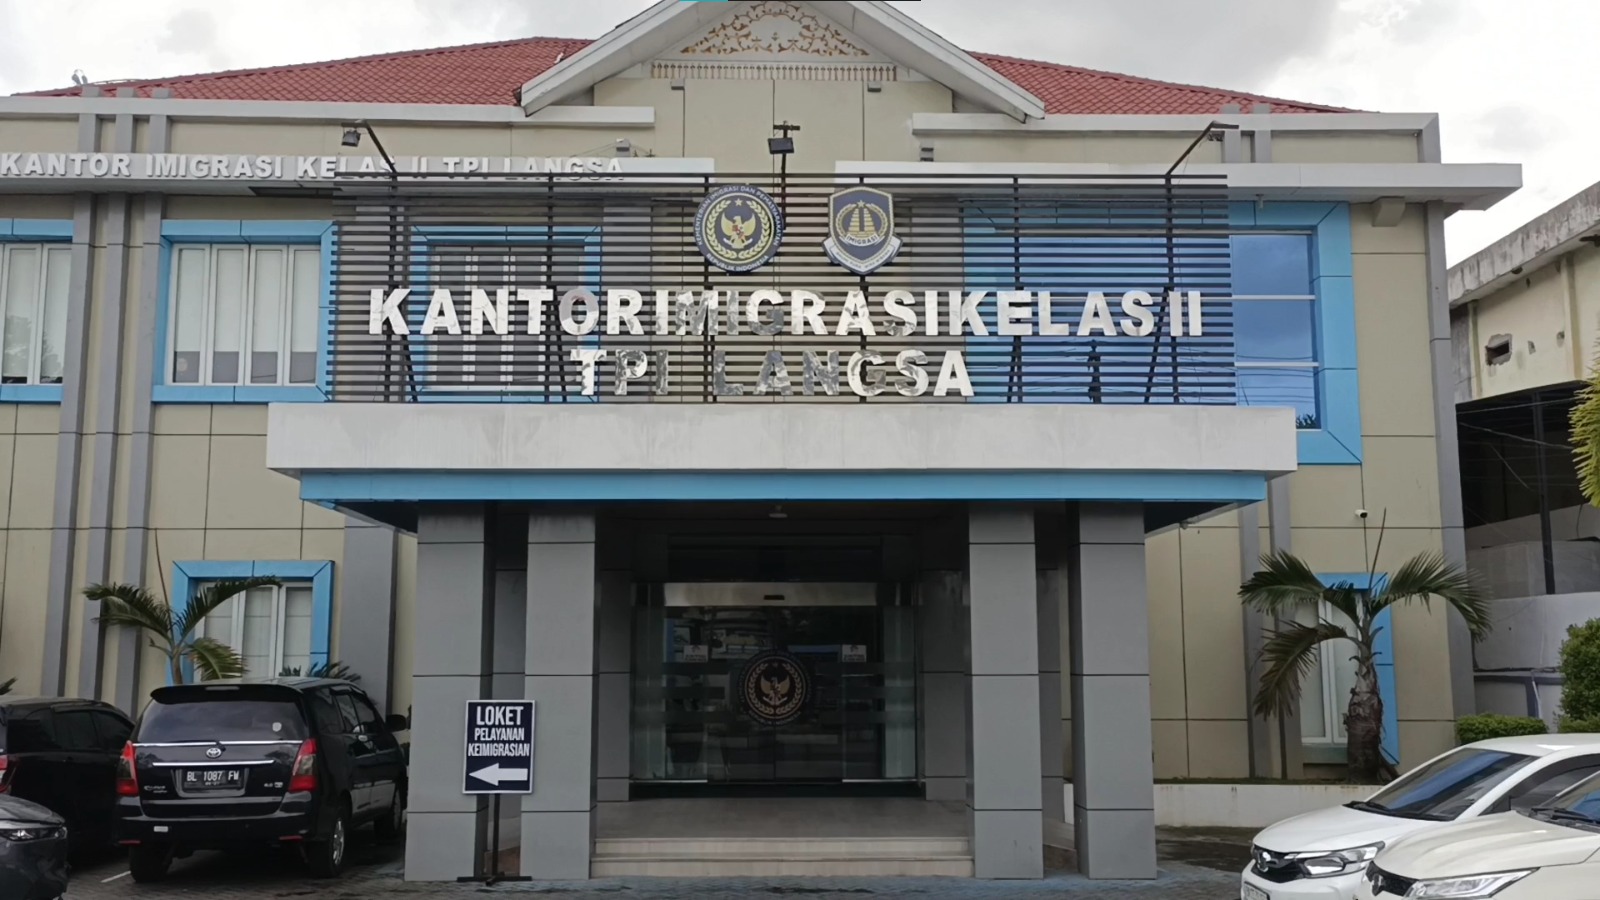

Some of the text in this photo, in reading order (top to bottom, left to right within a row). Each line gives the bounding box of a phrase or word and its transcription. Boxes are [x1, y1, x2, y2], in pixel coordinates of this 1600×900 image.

[1, 153, 624, 181] KANTOR IMIGRASI KELAS II TPI LANGSA
[695, 198, 711, 246] KEMENTERIAN
[710, 186, 739, 200] IMIGRASI
[740, 186, 755, 195] DAN
[847, 234, 879, 245] IMIGRASI
[706, 253, 769, 272] REPUBLIK INDONESIA
[570, 349, 975, 397] TPI LANGSA
[476, 705, 524, 726] LOKET
[474, 727, 525, 741] PELAYANAN
[468, 743, 530, 757] KEIMIGRASIAN
[186, 770, 240, 782] BL 1087 FW
